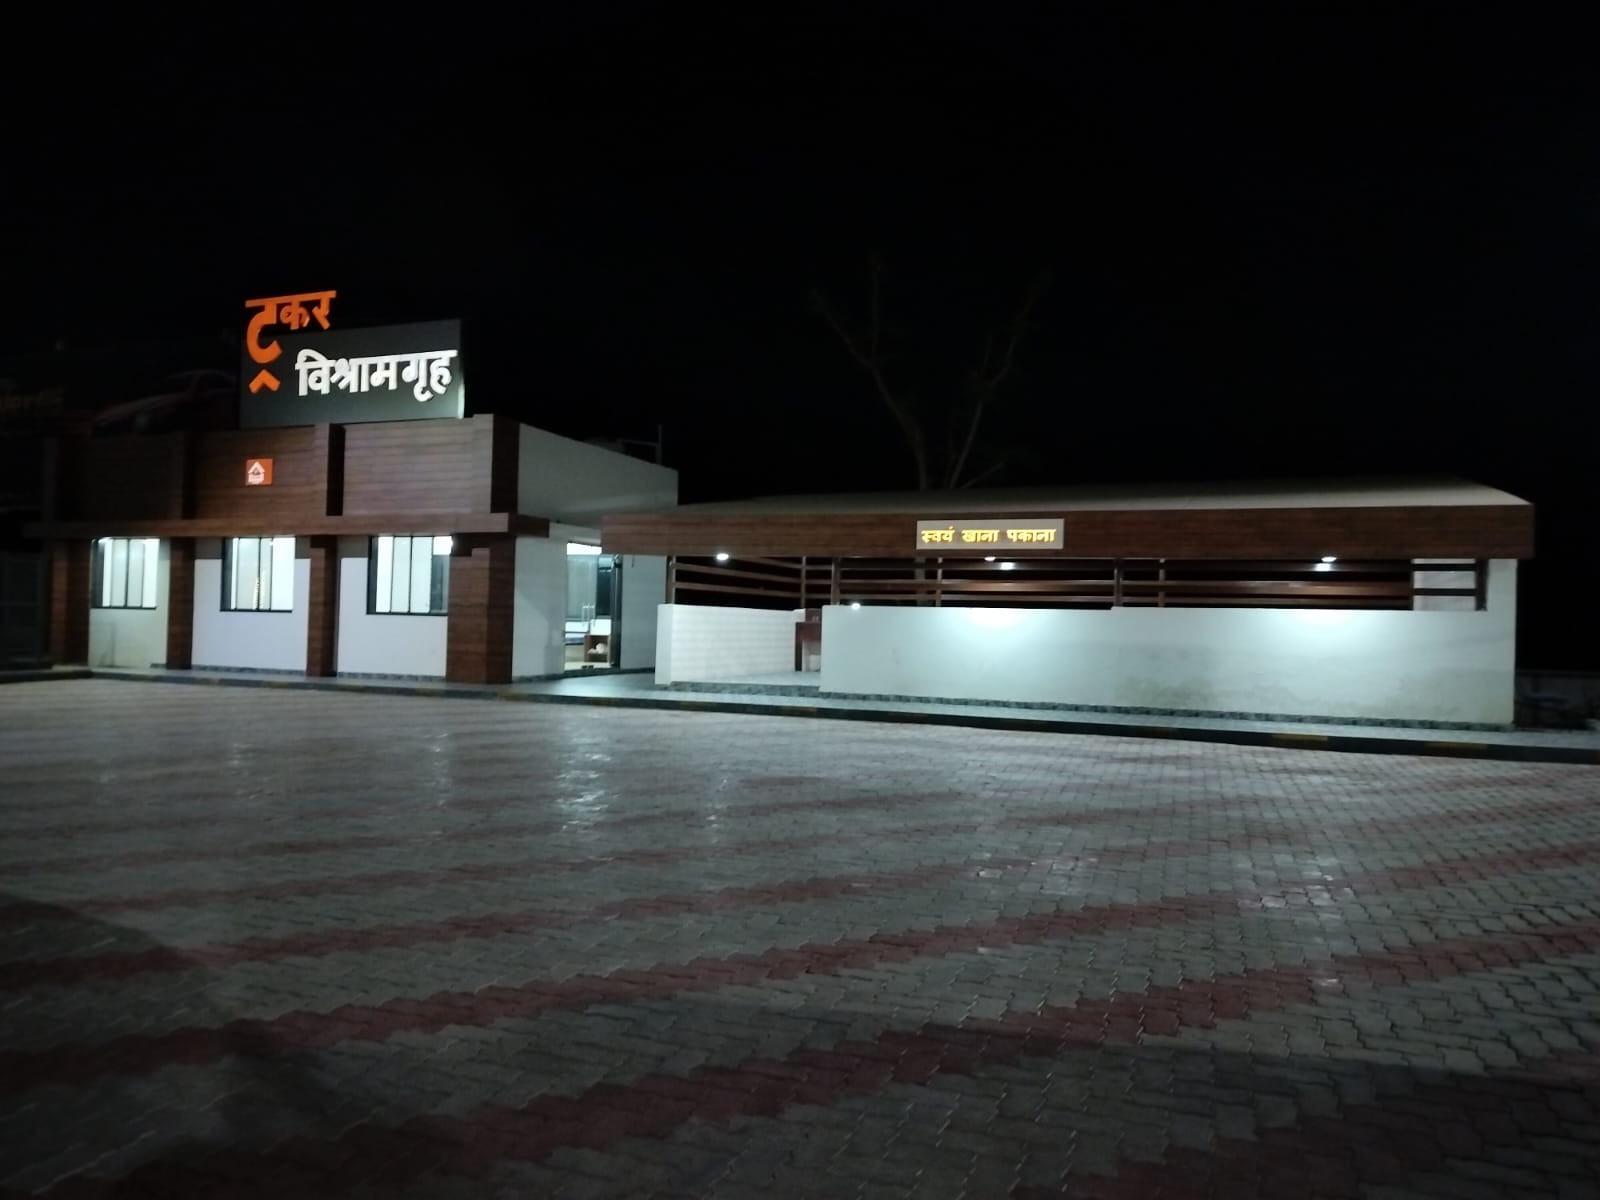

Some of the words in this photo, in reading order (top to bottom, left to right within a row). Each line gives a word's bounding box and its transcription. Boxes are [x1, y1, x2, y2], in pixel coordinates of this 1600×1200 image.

[920, 526, 956, 544] स्वयं
[961, 529, 1001, 544] खाना
[1006, 528, 1057, 543] पकाना
